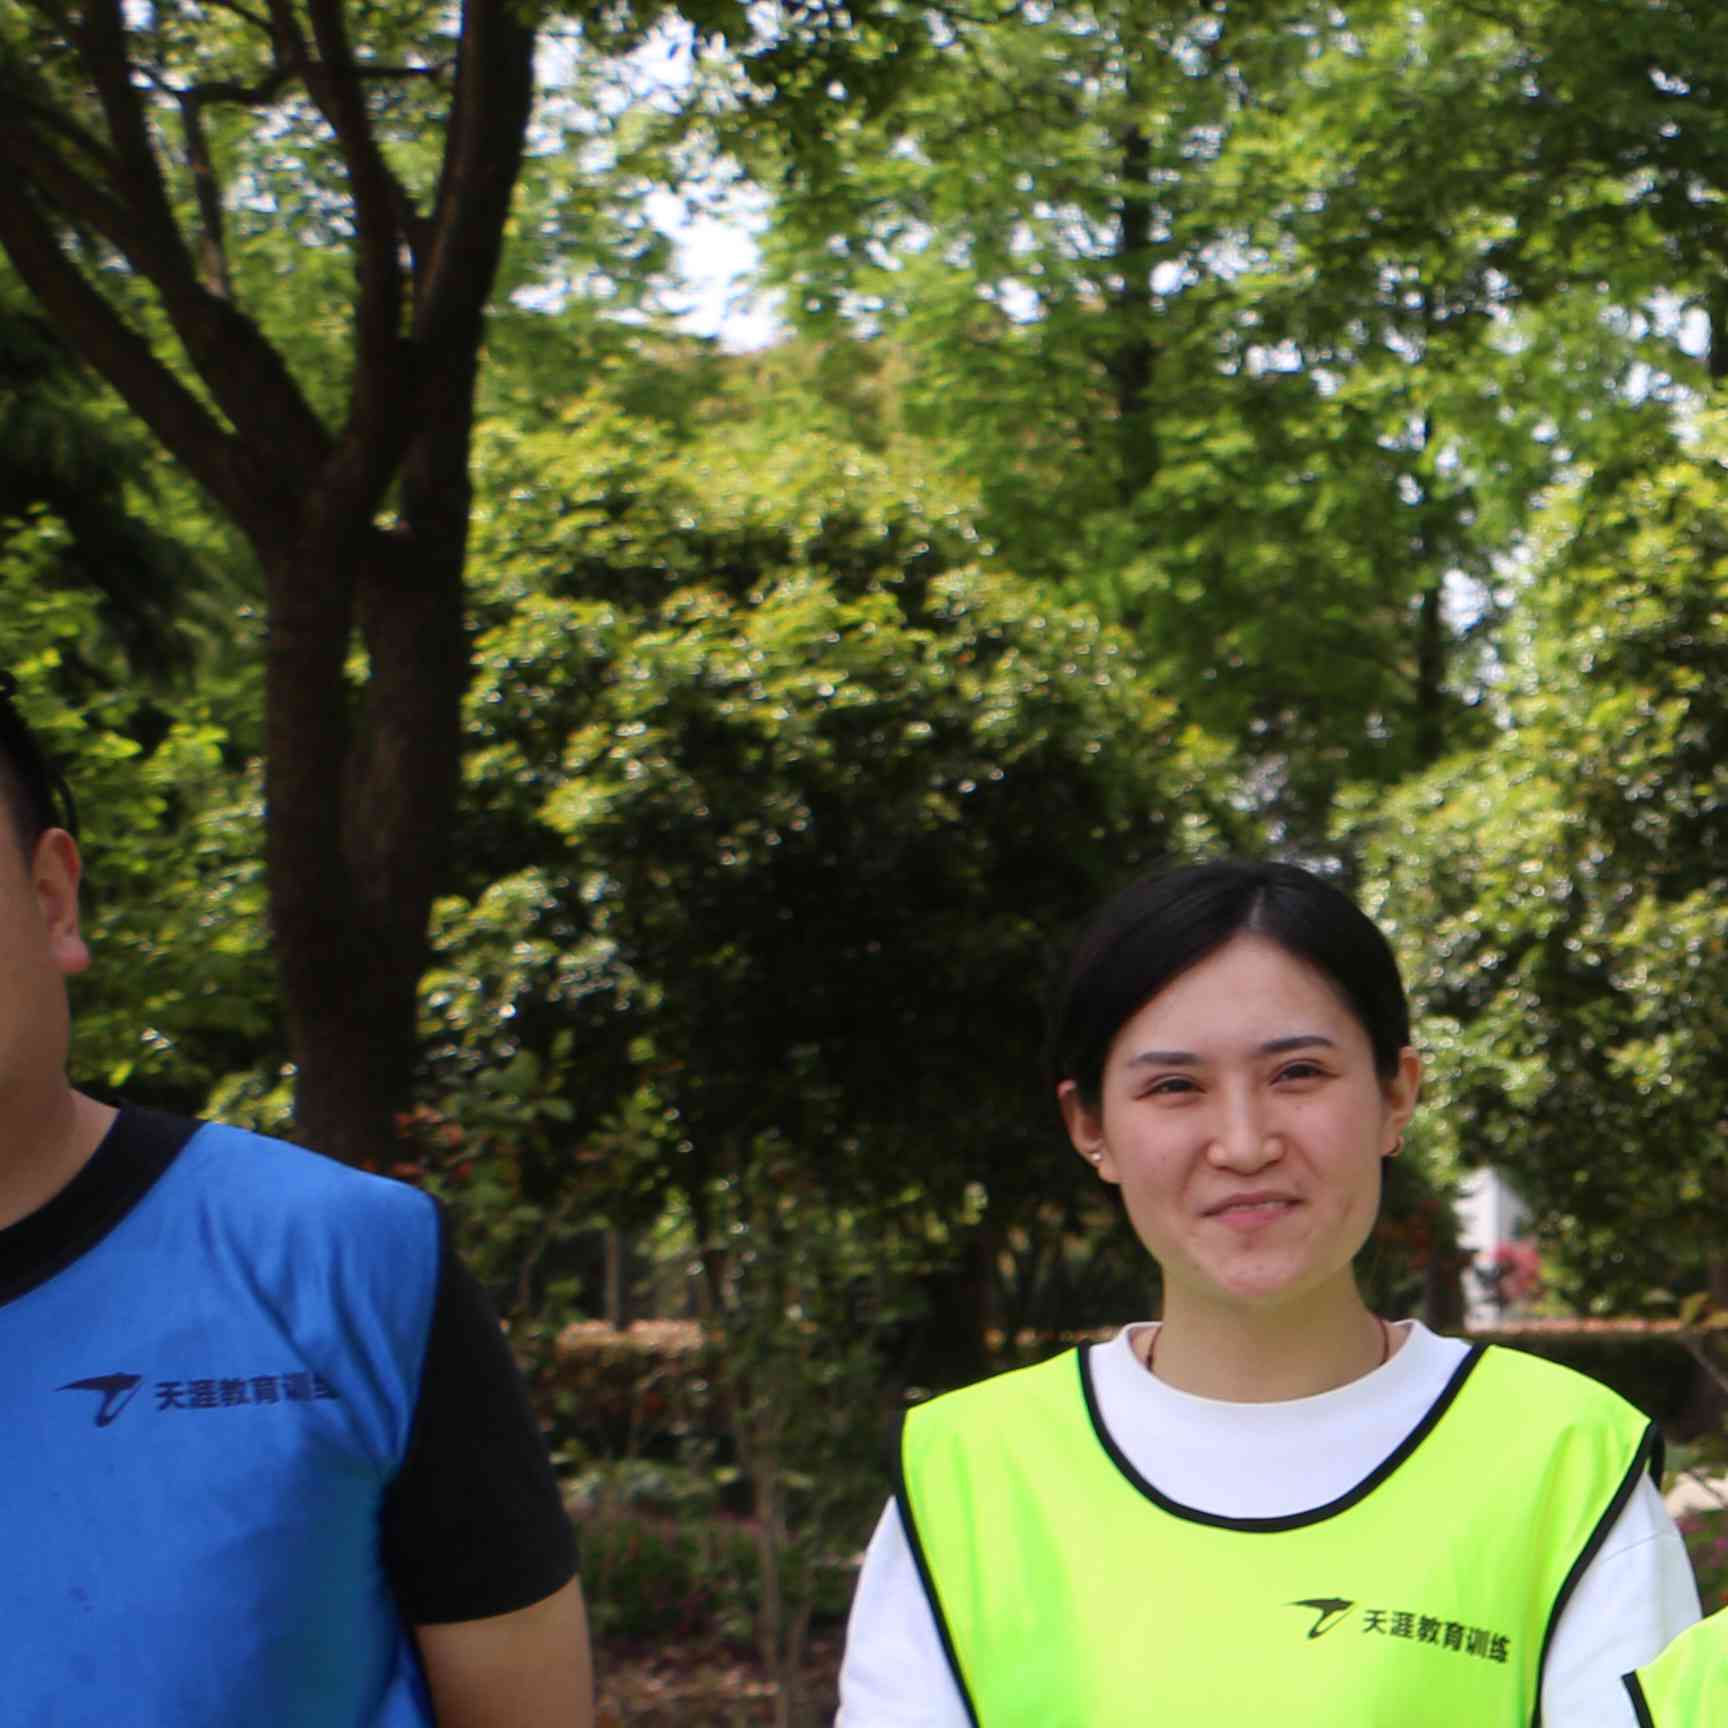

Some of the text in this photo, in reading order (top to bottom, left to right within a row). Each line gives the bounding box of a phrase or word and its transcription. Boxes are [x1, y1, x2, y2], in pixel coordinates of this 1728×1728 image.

[1362, 1608, 1511, 1664] 天涯教育训练
